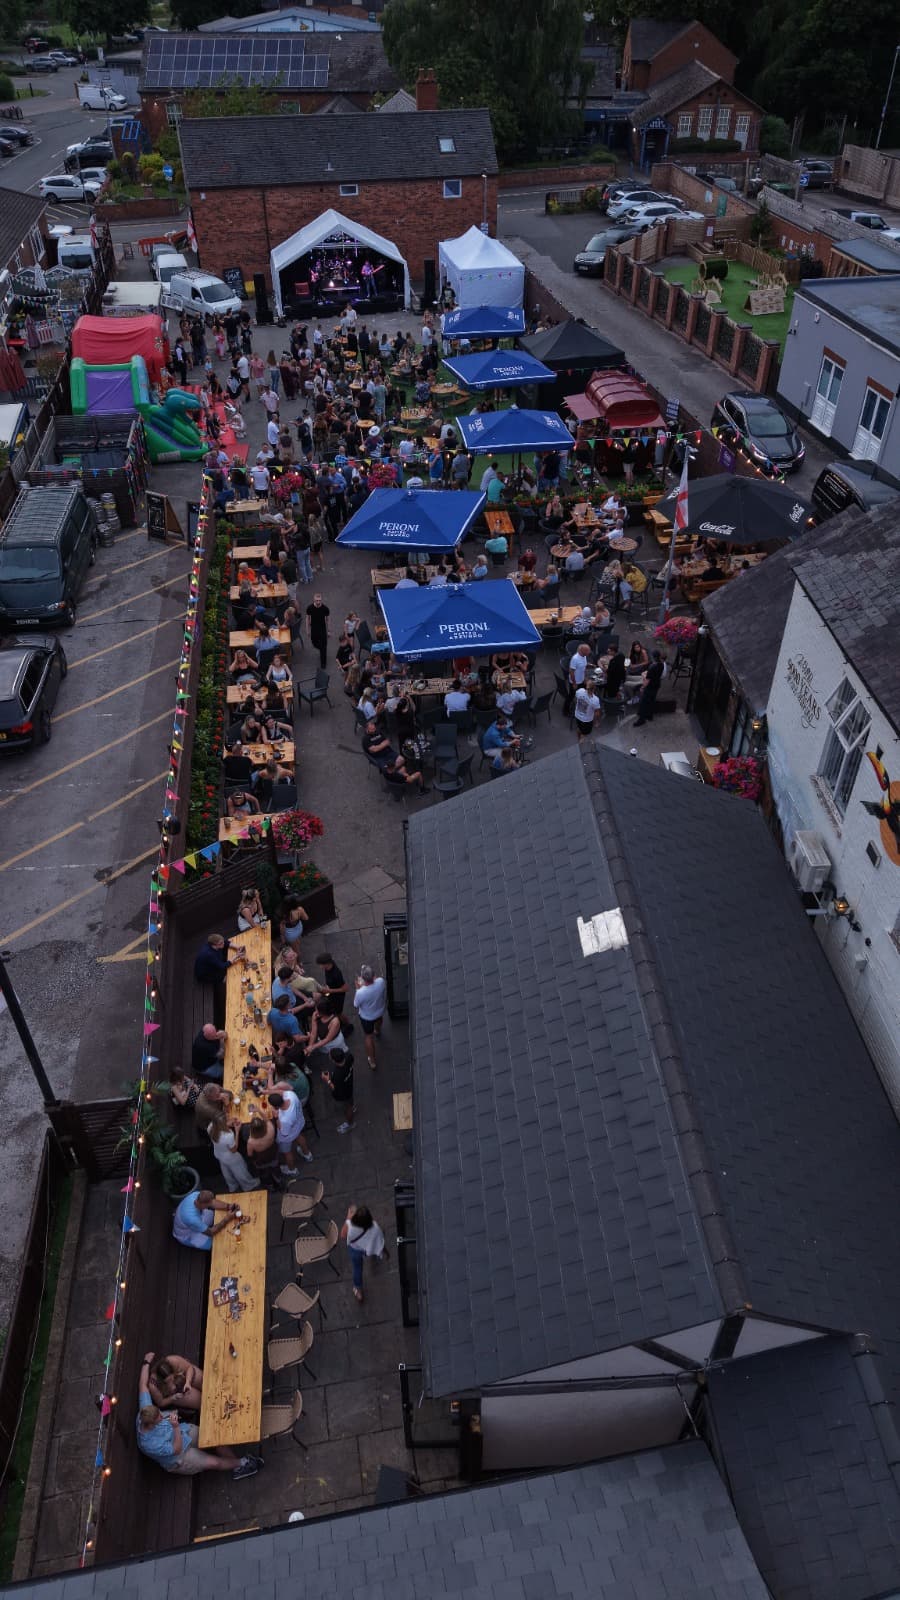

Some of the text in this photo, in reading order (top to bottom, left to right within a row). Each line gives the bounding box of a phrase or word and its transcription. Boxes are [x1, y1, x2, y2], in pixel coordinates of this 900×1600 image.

[379, 521, 420, 533] PERONI
[699, 521, 737, 536] Coca-Cola
[439, 621, 490, 635] PERONI
